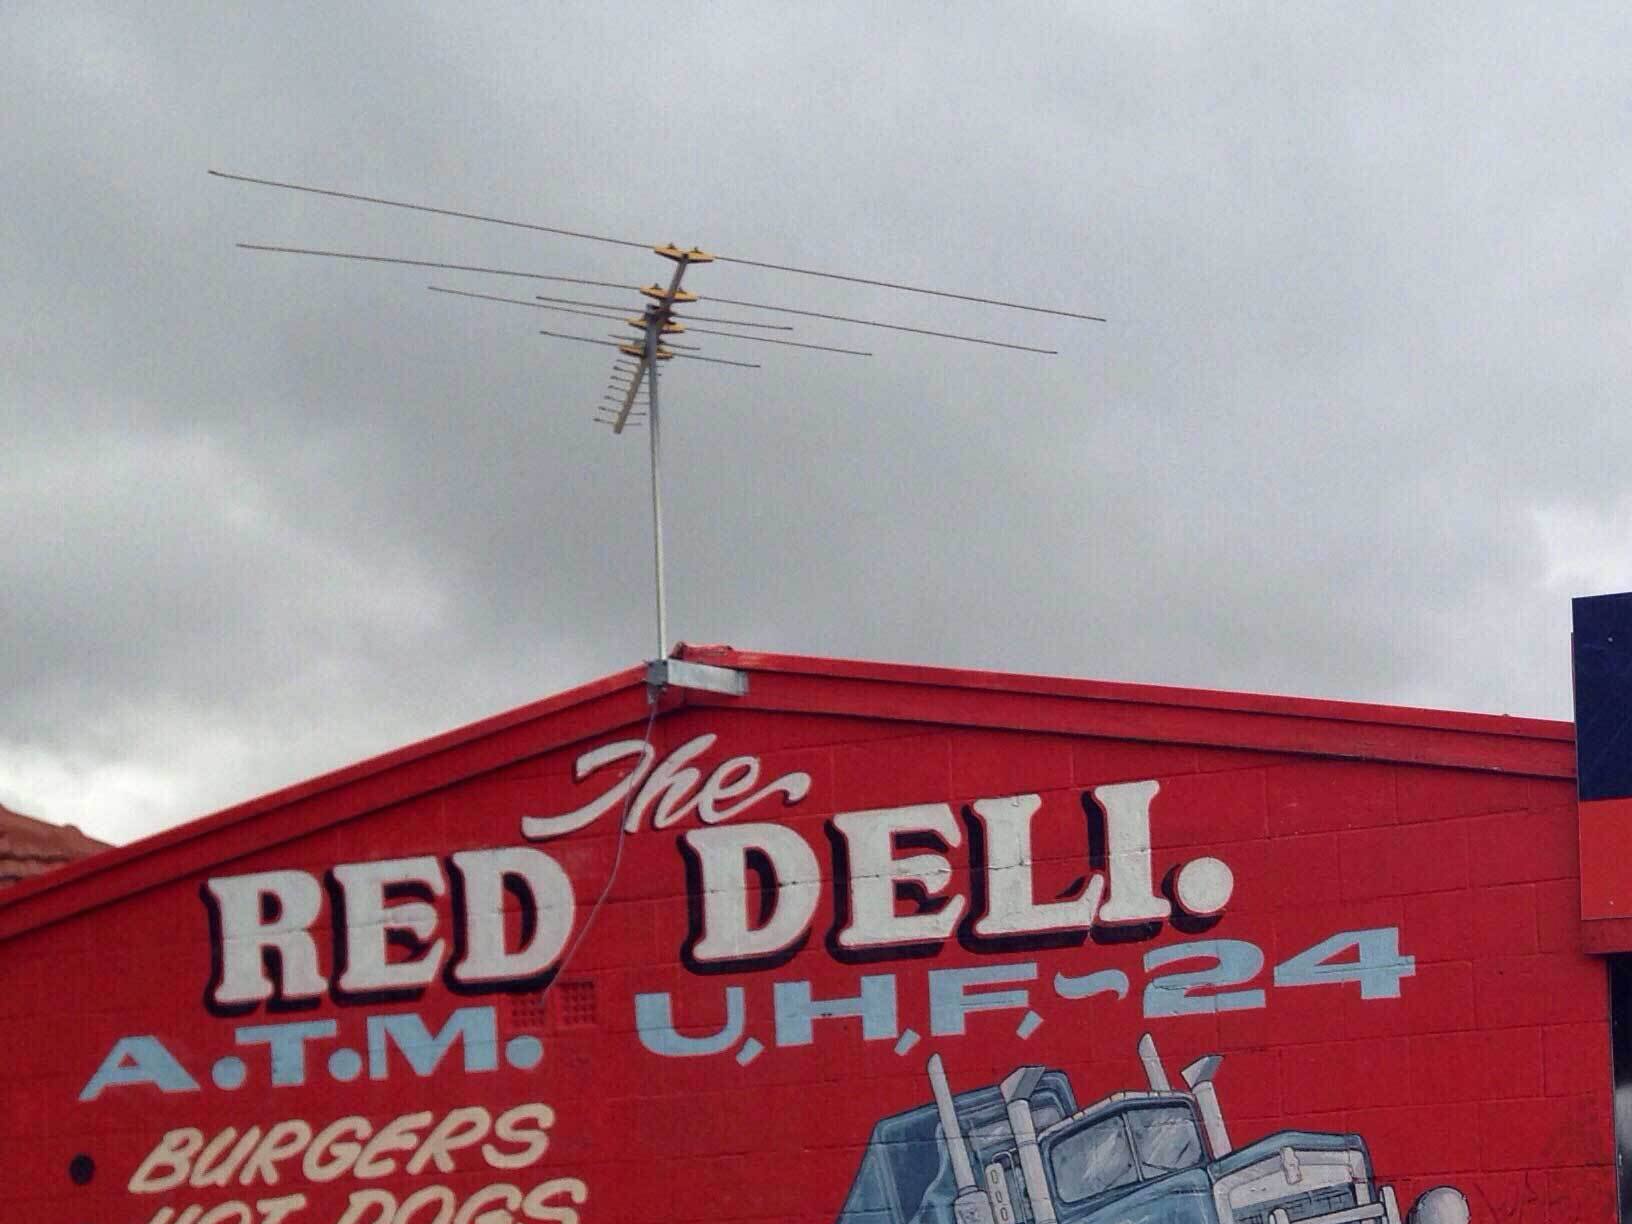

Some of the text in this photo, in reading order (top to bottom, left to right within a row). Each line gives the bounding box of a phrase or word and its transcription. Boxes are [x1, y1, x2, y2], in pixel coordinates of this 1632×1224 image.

[521, 733, 812, 839] The
[203, 779, 1235, 1012] RED DELI.
[79, 1005, 543, 1100] A.T.M.
[128, 1102, 555, 1194] BURGERS
